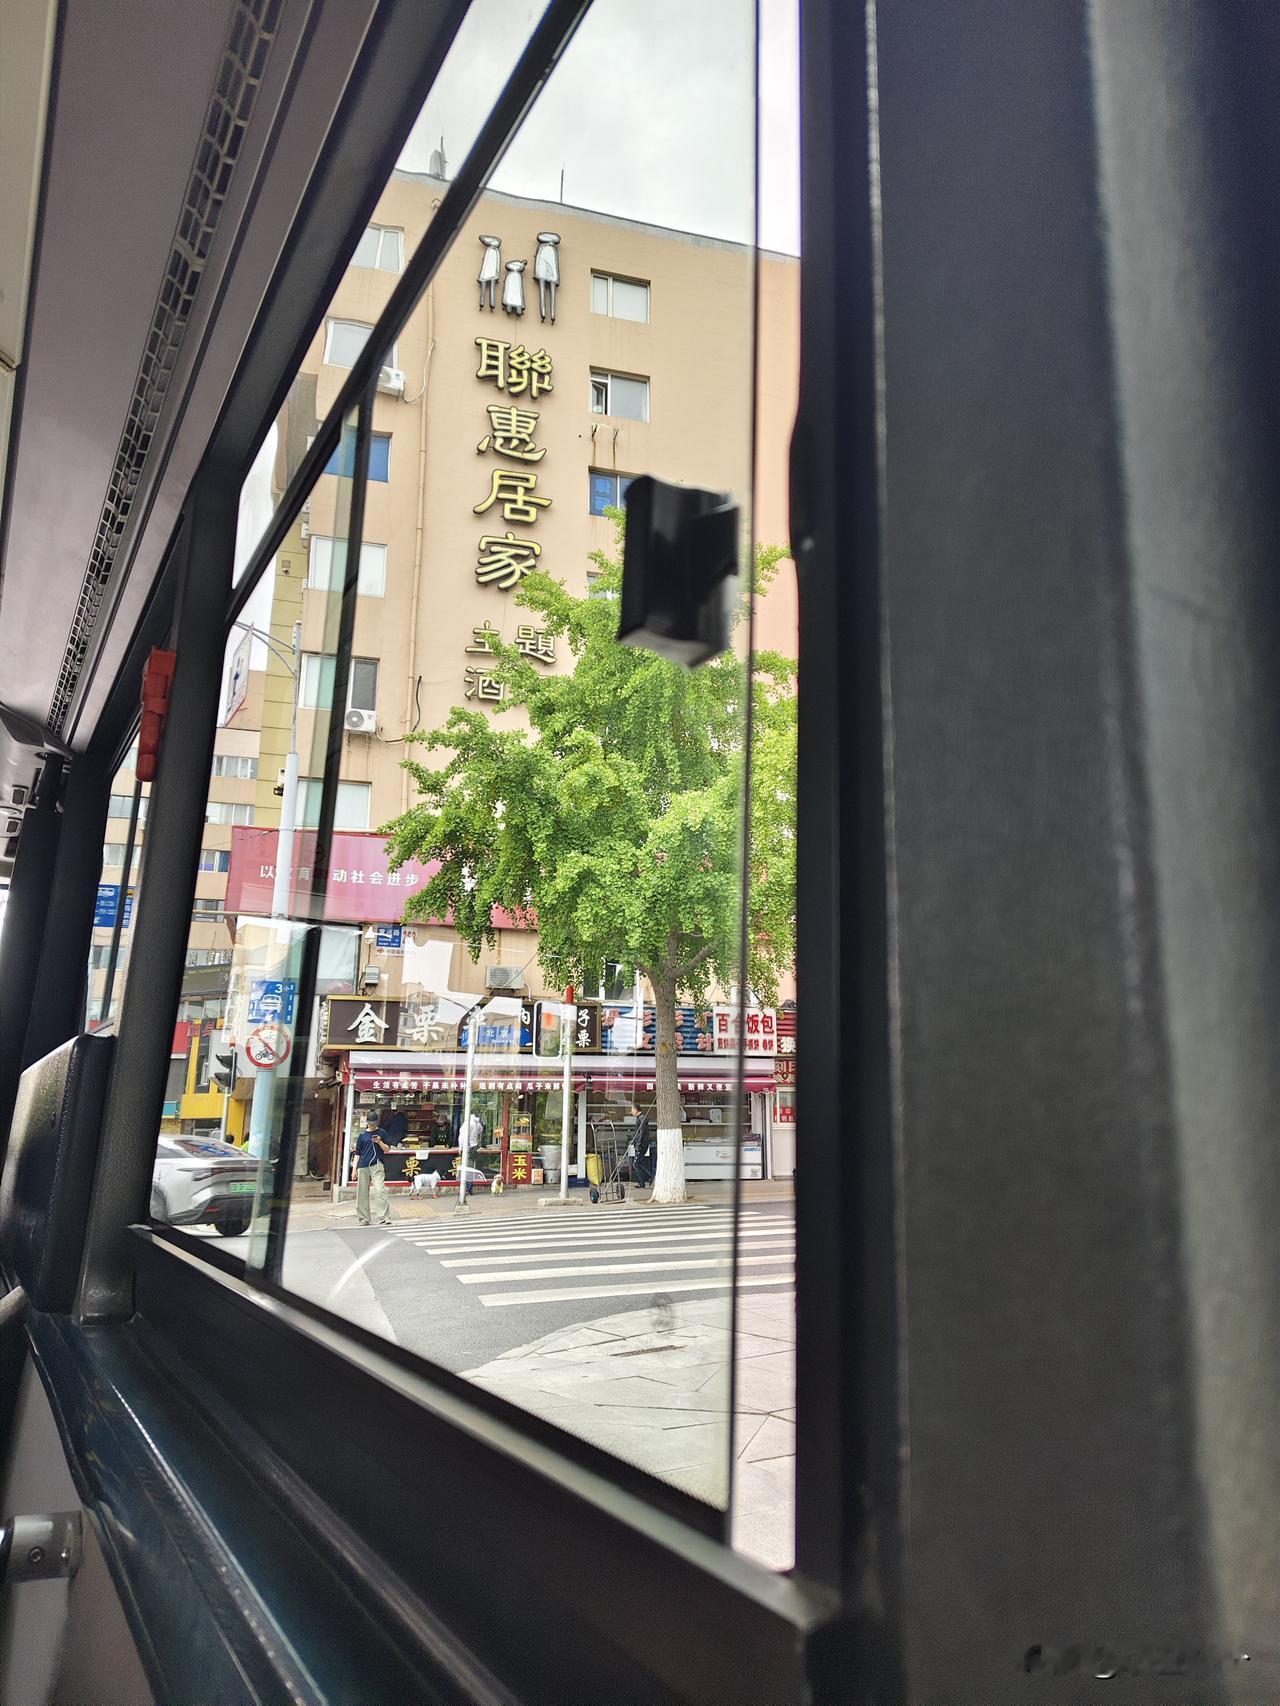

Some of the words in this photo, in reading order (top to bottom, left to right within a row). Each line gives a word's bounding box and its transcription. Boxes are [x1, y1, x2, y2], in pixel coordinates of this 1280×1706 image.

[473, 336, 553, 590] 聯惠居家
[259, 864, 420, 887] 以育动社会进步
[511, 1154, 528, 1181] 玉米
